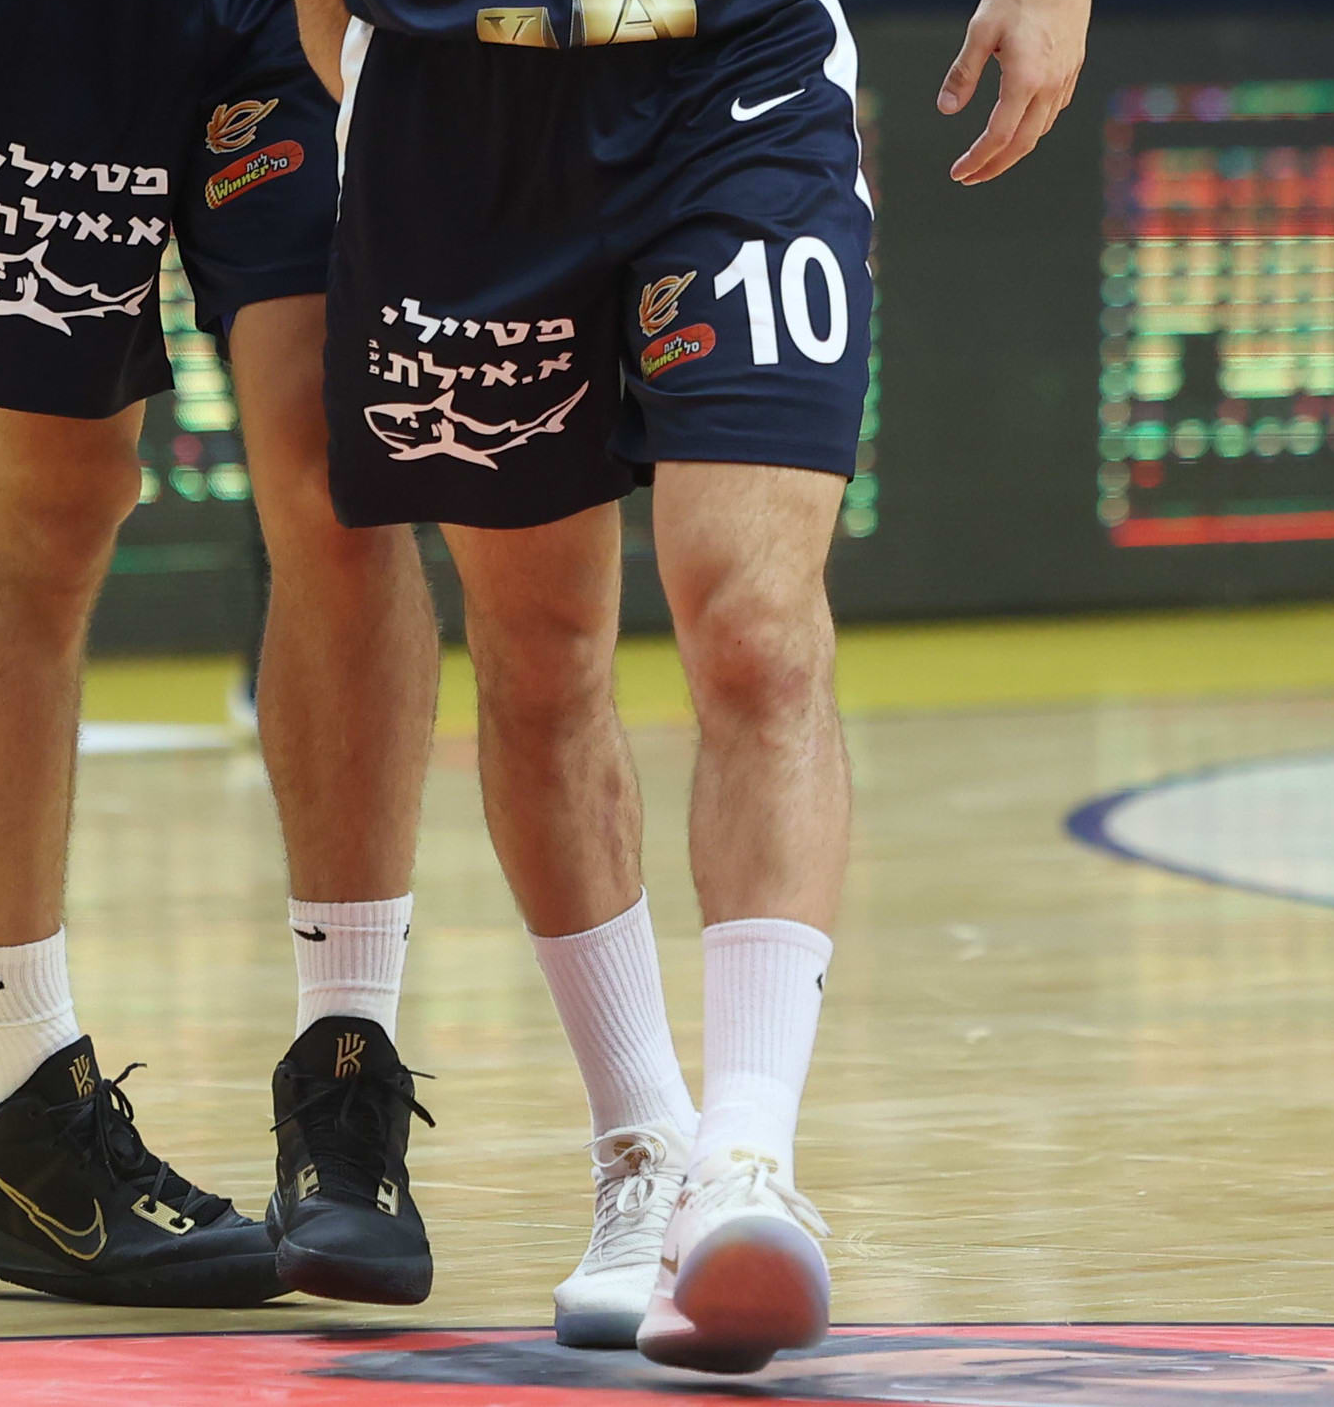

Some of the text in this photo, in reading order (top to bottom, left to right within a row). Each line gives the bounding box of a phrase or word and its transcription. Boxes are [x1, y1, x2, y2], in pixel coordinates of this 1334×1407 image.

[246, 153, 268, 172] ליגת
[270, 157, 288, 170] סל
[214, 164, 269, 200] Winner
[713, 236, 848, 366] 10
[381, 297, 576, 347] מטיילי
[683, 341, 699, 354] סל
